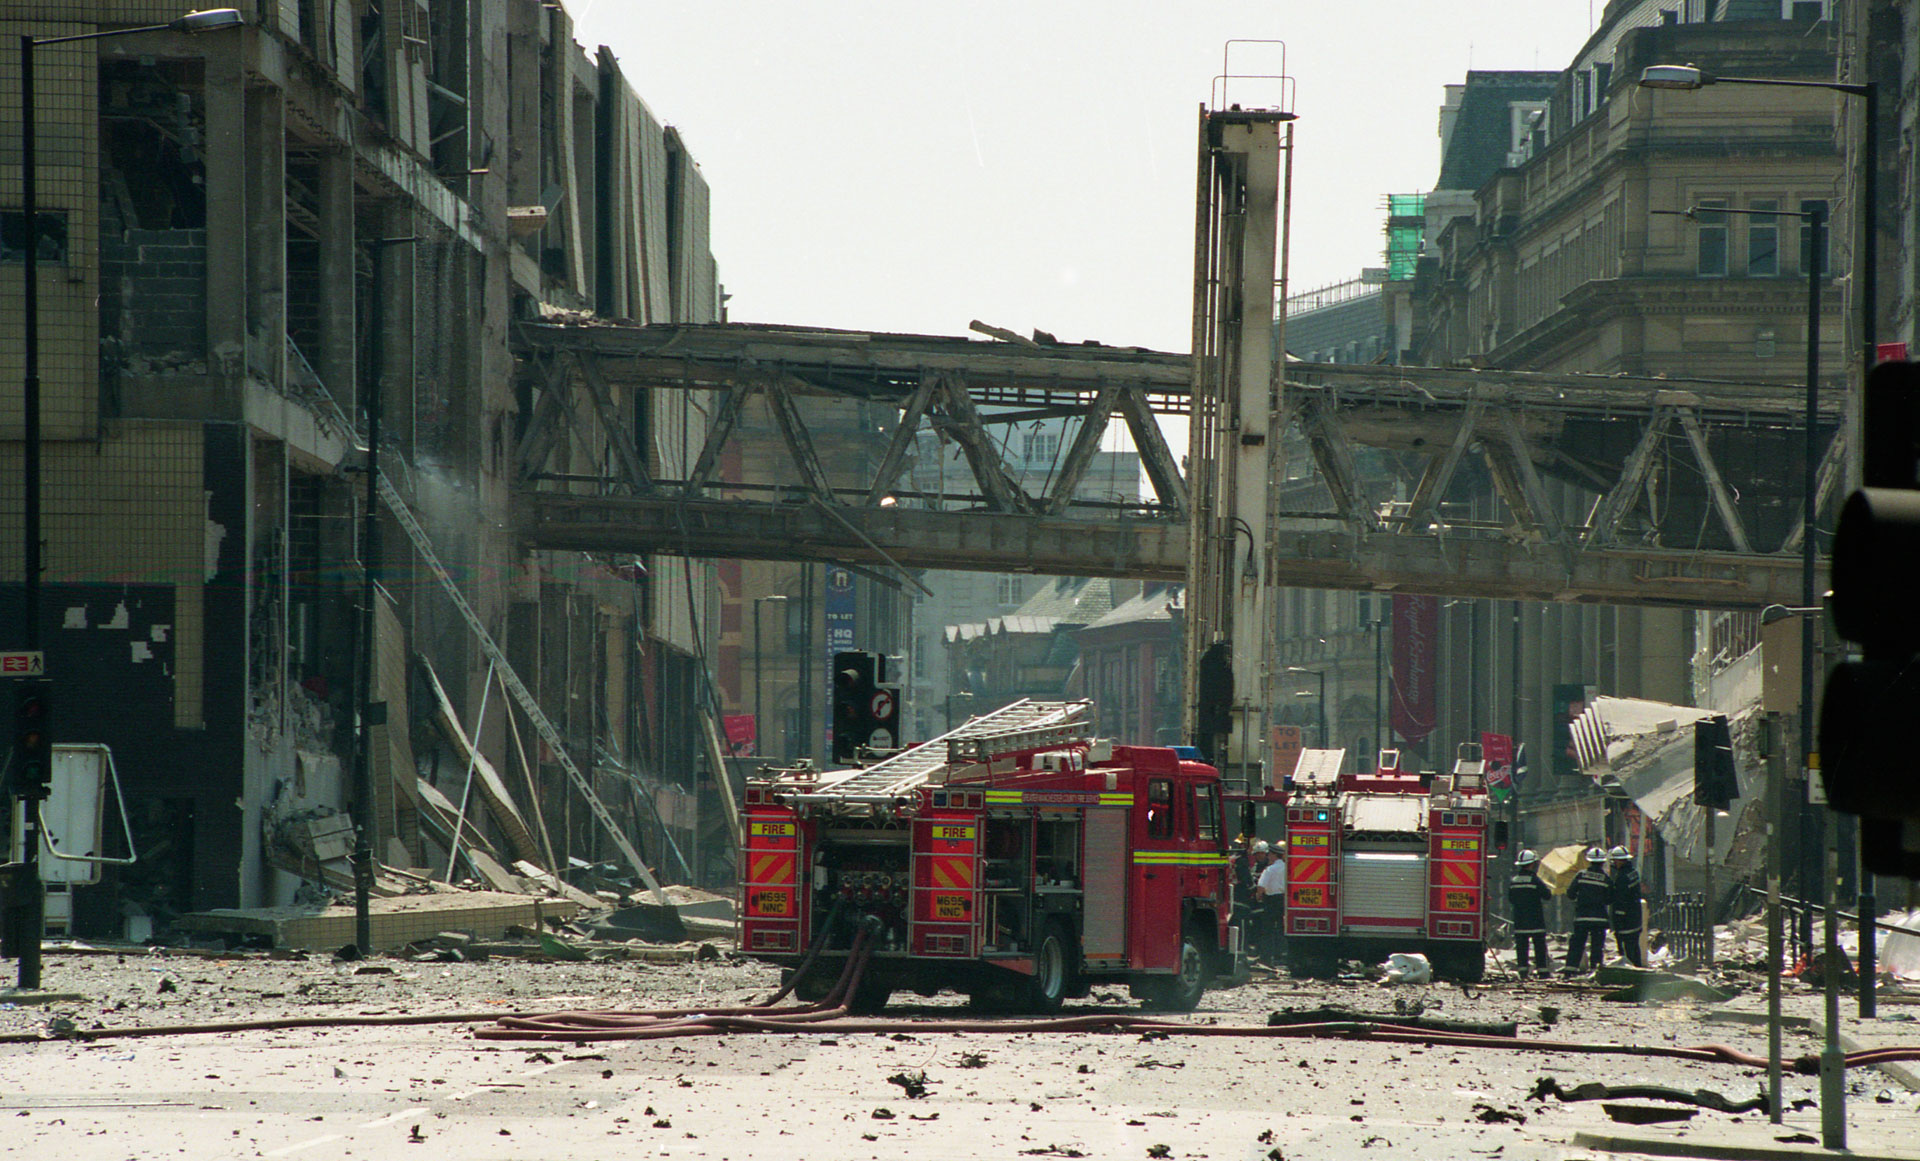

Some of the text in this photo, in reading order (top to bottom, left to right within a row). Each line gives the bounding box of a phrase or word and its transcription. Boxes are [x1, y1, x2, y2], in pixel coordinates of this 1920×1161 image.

[833, 629, 853, 639] HQ
[1405, 595, 1426, 704] Royal Exchange
[1279, 728, 1296, 736] TO
[1274, 741, 1298, 749] LET
[761, 824, 786, 834] FIRE
[942, 827, 967, 838] FIRE
[1300, 836, 1321, 844] FIRE
[1450, 840, 1471, 849] FIRE
[760, 892, 787, 902] M695
[936, 896, 964, 906] M695
[1301, 896, 1319, 905] NNC
[762, 902, 784, 913] NNC
[1448, 901, 1466, 909] NNC
[938, 906, 961, 917] NNC
